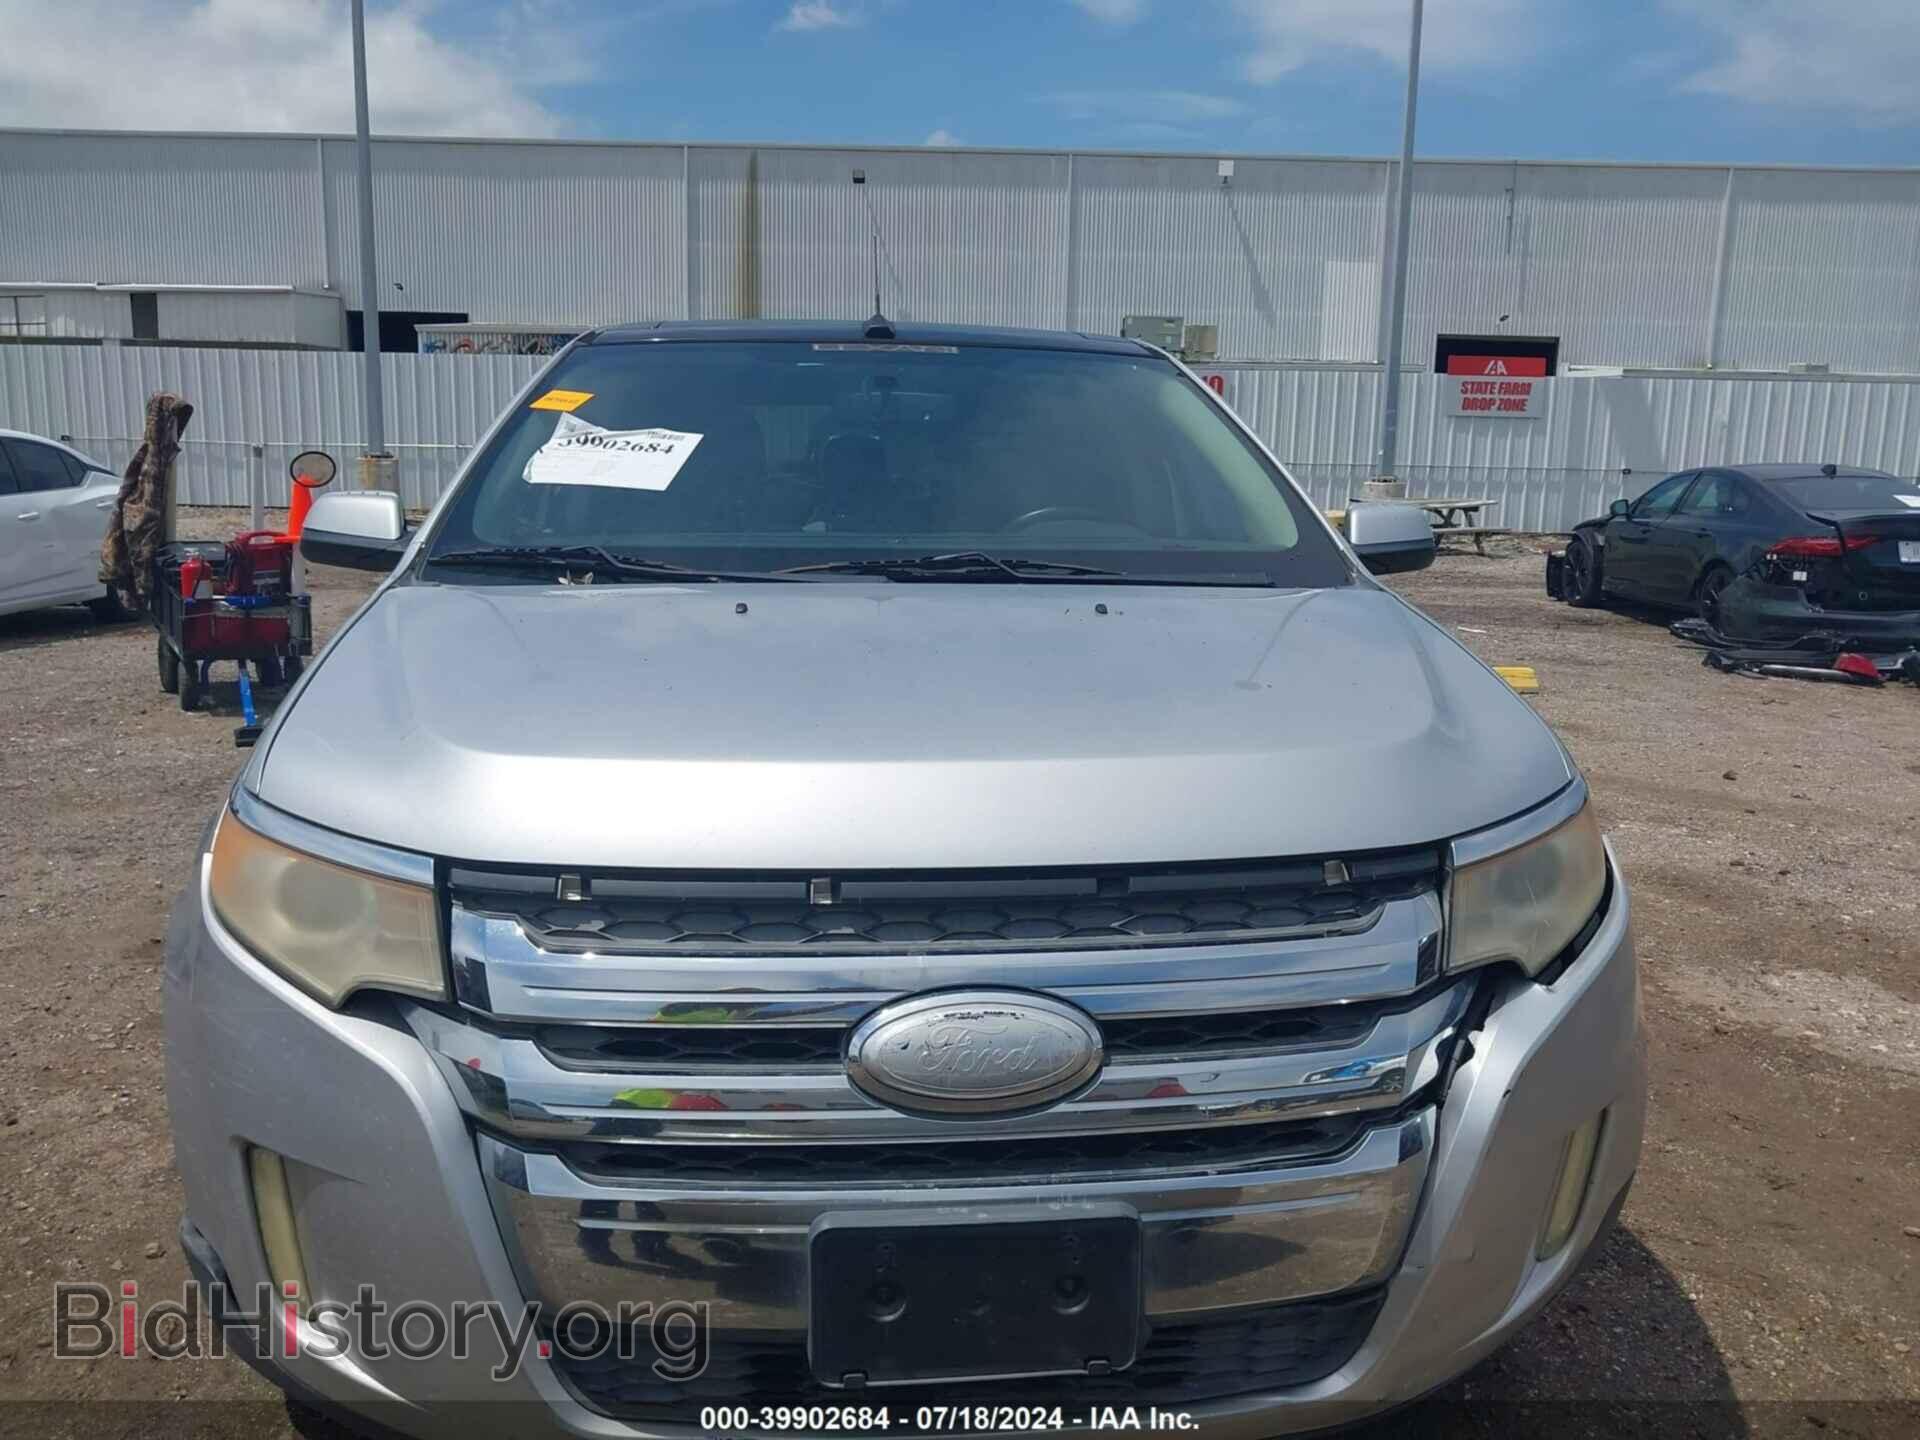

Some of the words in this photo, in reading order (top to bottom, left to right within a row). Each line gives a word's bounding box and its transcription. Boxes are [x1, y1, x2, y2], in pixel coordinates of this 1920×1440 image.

[1460, 381, 1496, 395] STATE
[1497, 382, 1532, 396] FARM
[1461, 397, 1495, 411] DROP
[1496, 398, 1529, 412] ZONE
[917, 1024, 1043, 1073] Ford
